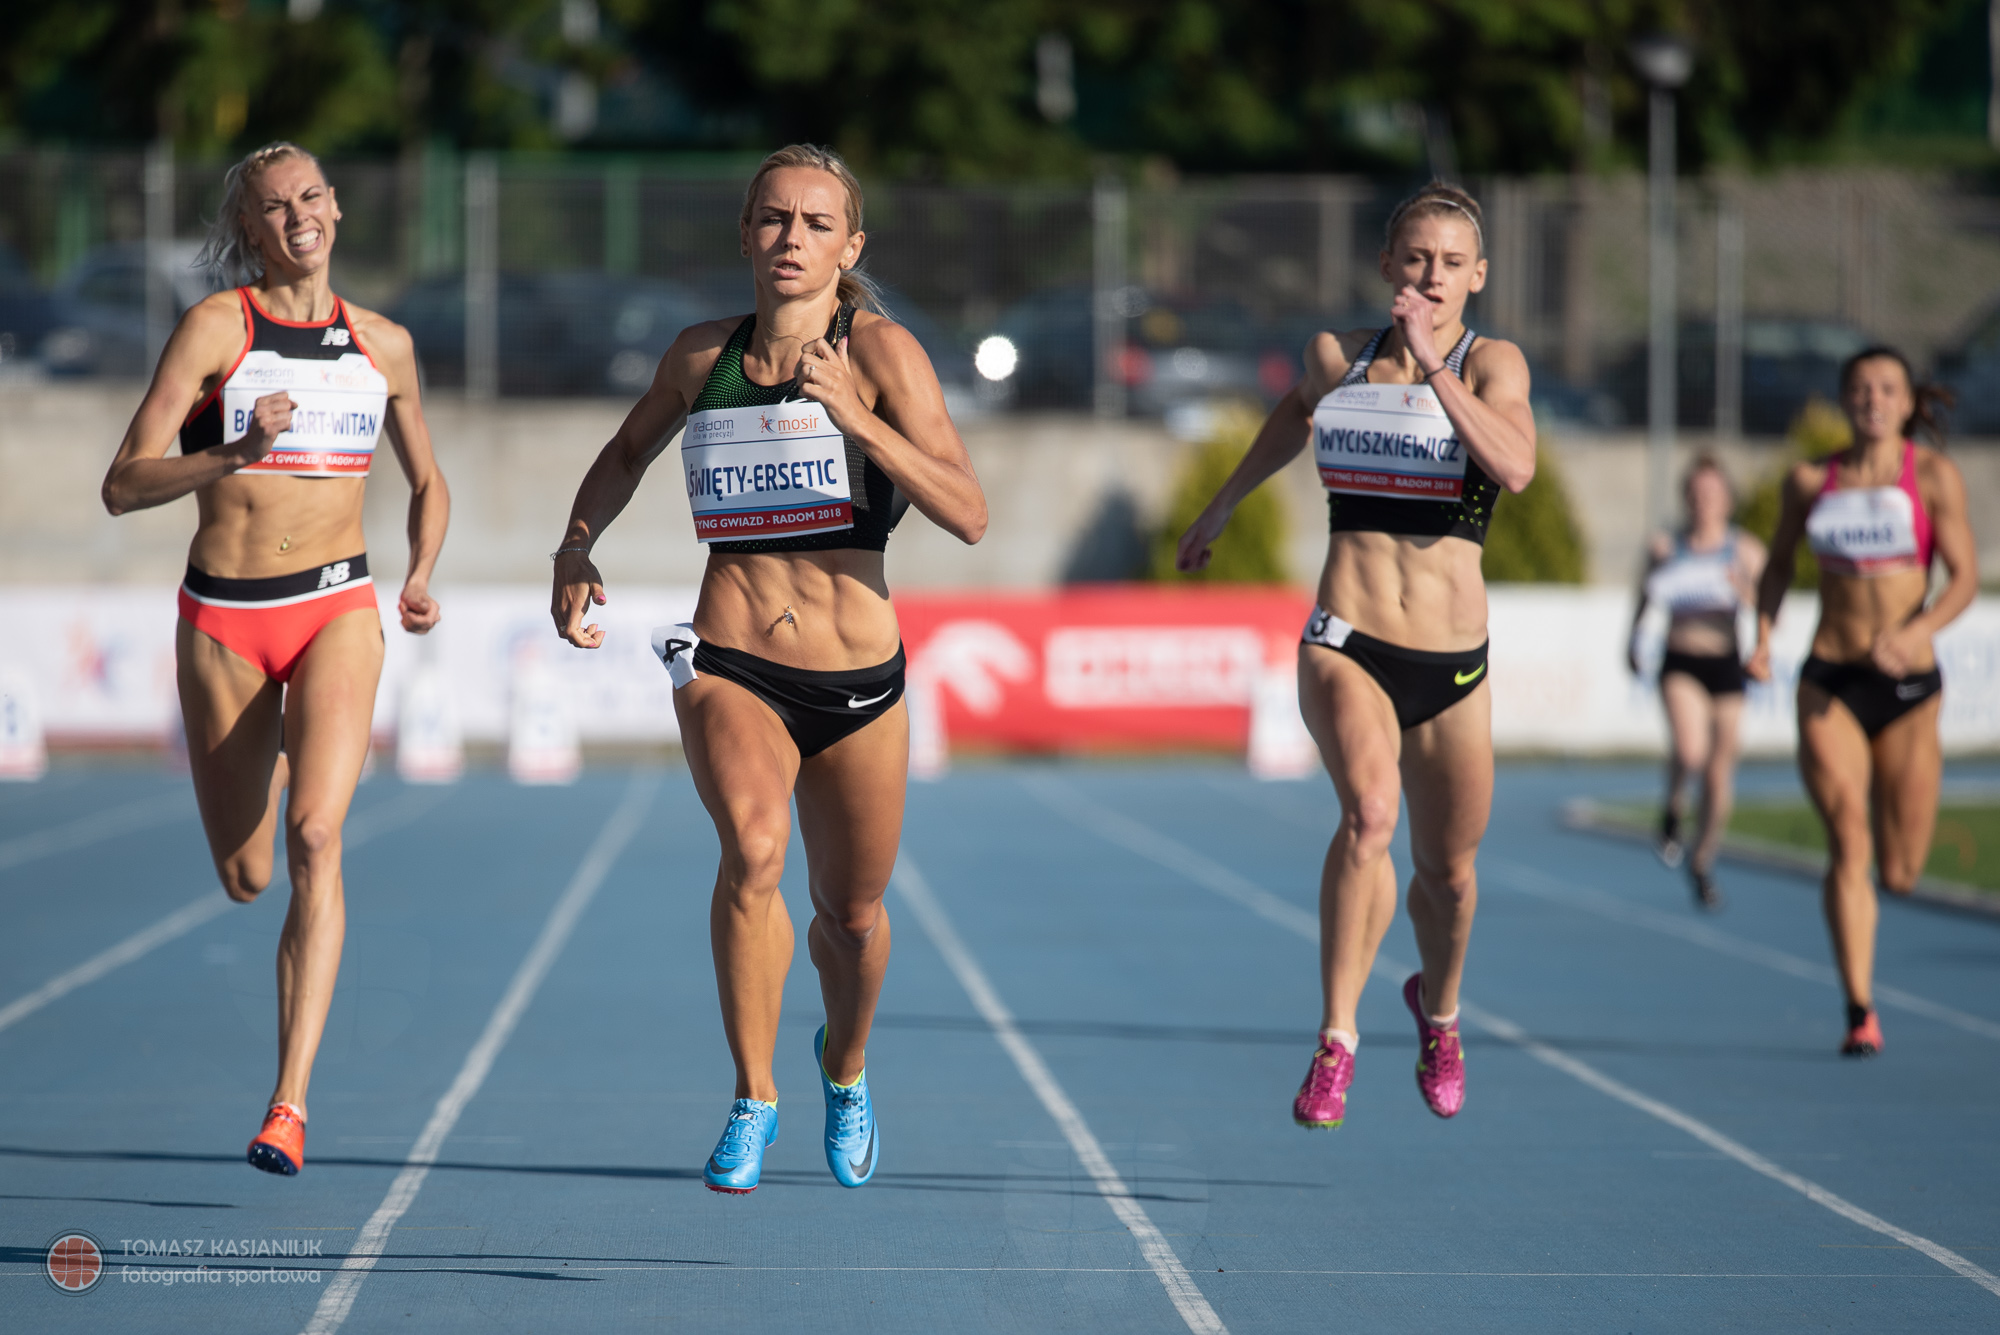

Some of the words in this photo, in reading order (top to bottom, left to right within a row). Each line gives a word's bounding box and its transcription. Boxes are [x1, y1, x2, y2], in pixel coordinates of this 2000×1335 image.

[320, 327, 350, 346] NB
[233, 408, 378, 437] BAART-WITAN
[692, 419, 734, 432] radom
[778, 414, 819, 431] mosir
[1318, 427, 1461, 462] WYCISZKIEWICZ
[689, 458, 837, 501] ŚWIĘTY-ERSETIC
[1394, 477, 1432, 489] RADOM
[720, 515, 764, 528] GWIAZD
[772, 511, 815, 525] RADOM
[818, 507, 842, 520] 2018
[317, 561, 351, 590] NB
[663, 638, 693, 664] 4
